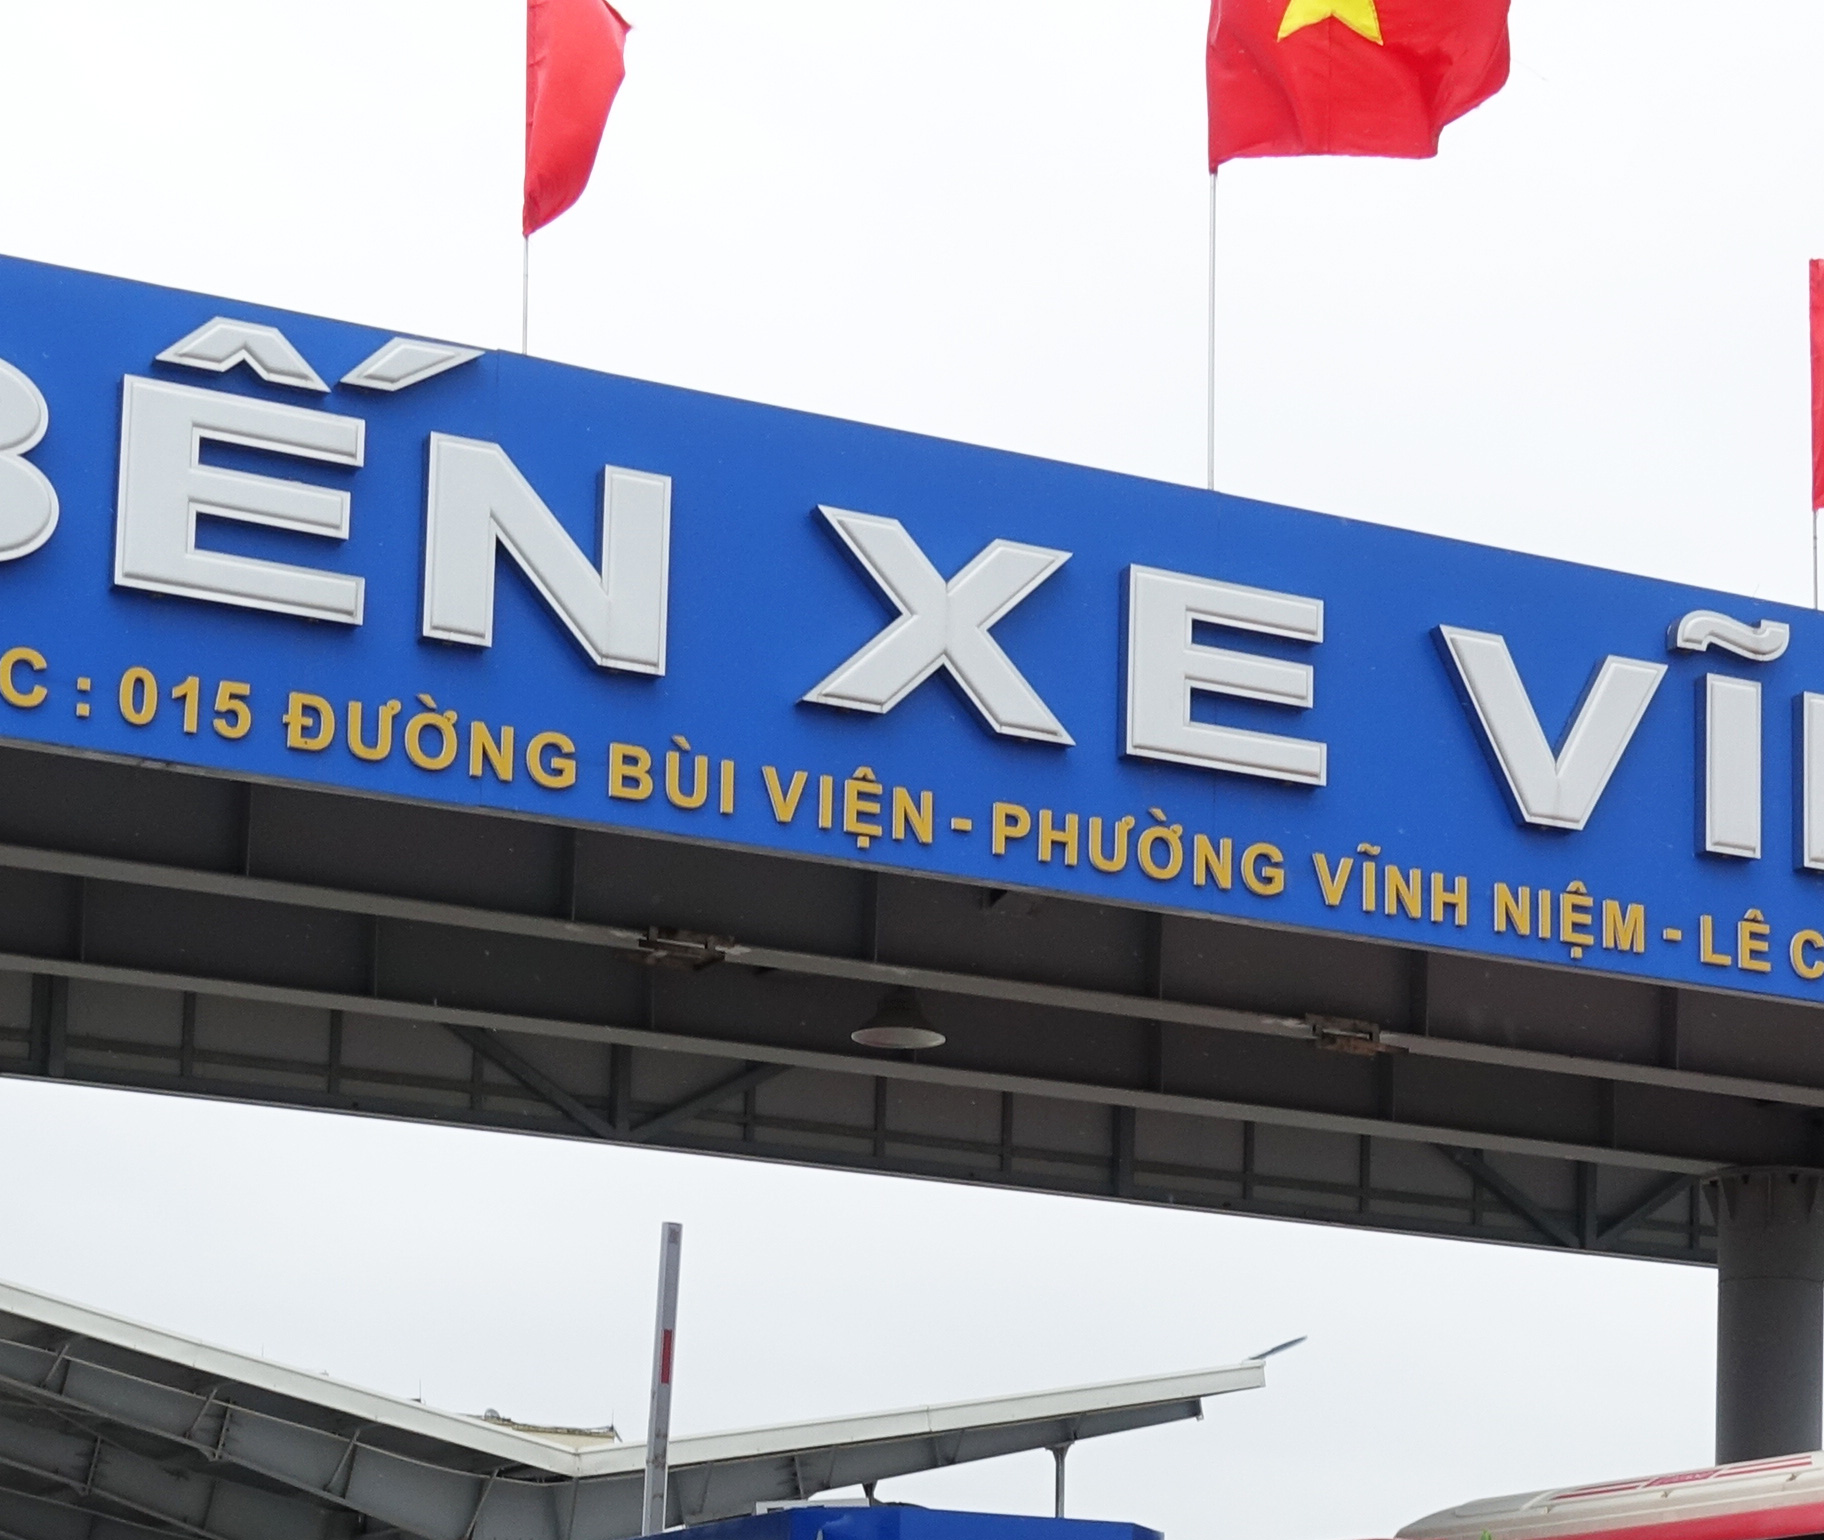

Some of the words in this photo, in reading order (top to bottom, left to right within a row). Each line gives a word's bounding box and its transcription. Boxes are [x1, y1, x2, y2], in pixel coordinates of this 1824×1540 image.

[798, 503, 1327, 787] XE
[117, 667, 252, 740] 015
[282, 690, 577, 791] ĐƯỜNG
[608, 735, 735, 816] BÙI
[762, 764, 934, 851] VIỆN
[991, 801, 1286, 898] PHƯỜNG
[1313, 843, 1469, 926] VĨNH
[1493, 880, 1645, 960] NIỆM
[1699, 908, 1773, 974] LÊ
